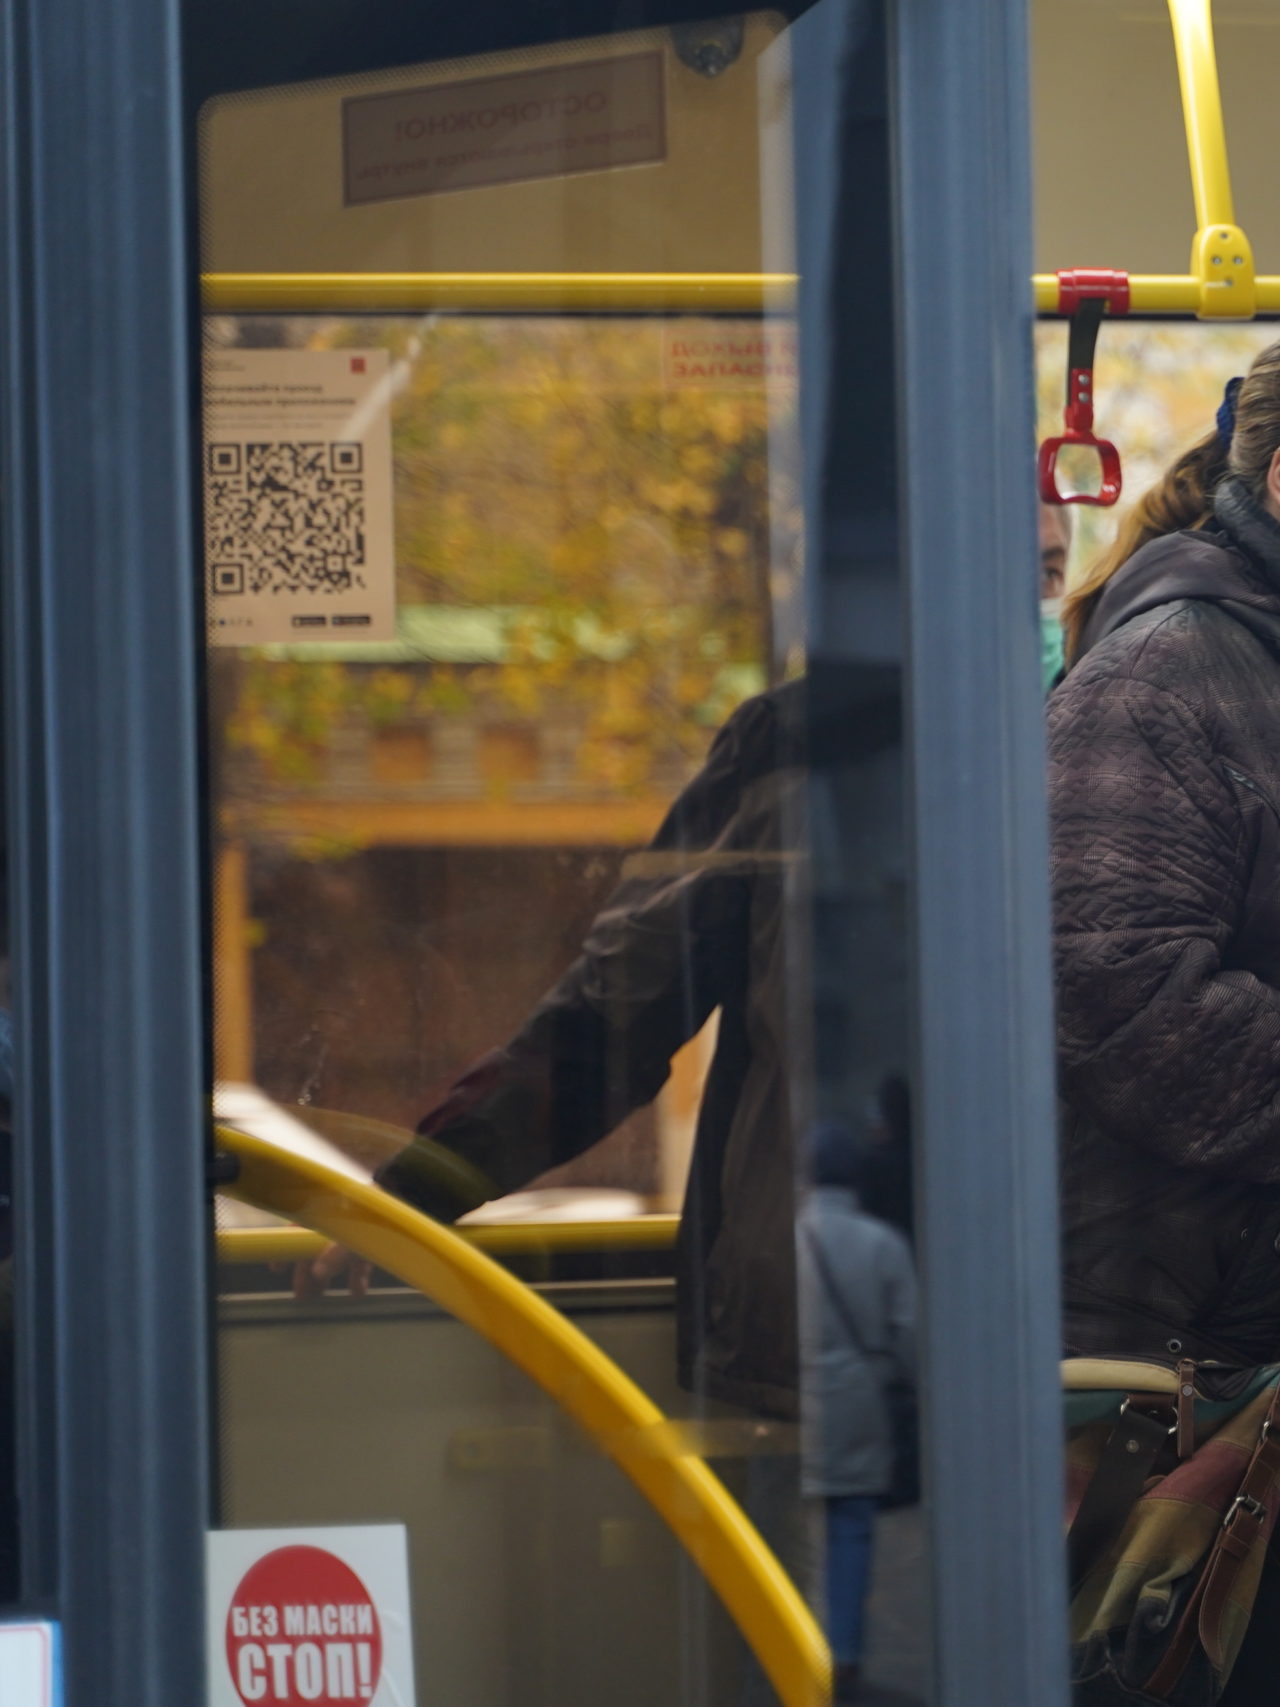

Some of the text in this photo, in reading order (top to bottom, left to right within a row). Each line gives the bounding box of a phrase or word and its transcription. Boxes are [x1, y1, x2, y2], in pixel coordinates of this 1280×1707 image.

[232, 1603, 374, 1638] БЕЗ МАСКИ
[236, 1641, 374, 1701] СТОП!
